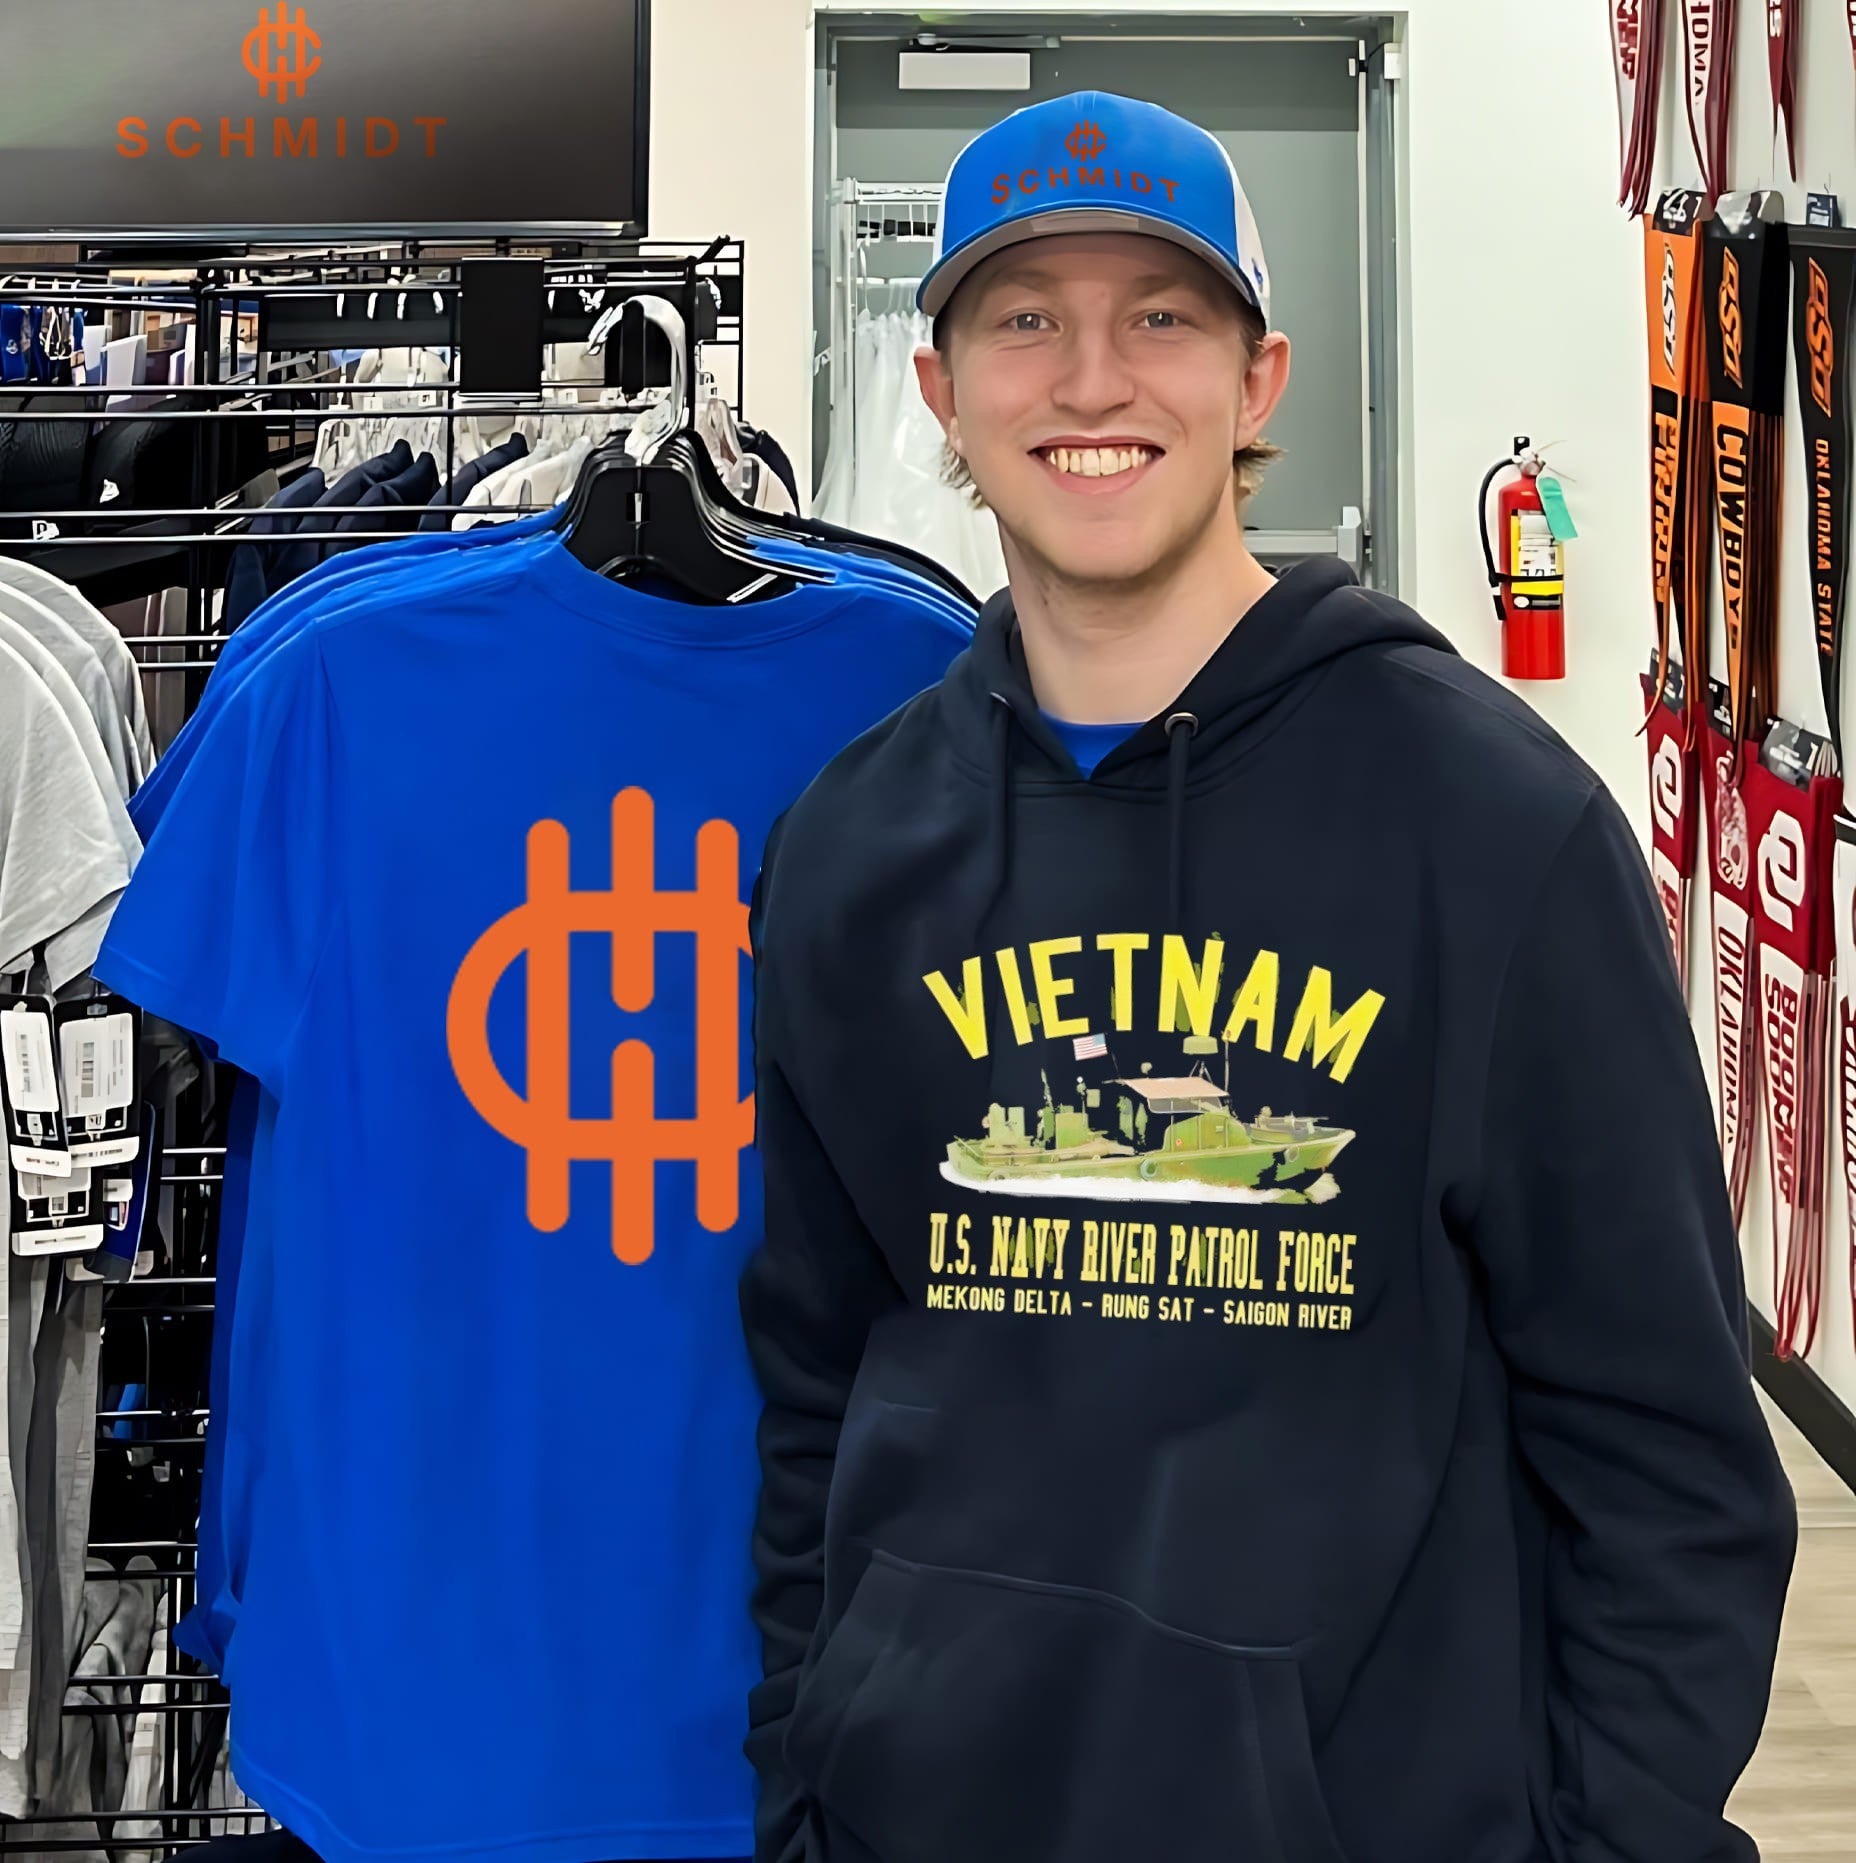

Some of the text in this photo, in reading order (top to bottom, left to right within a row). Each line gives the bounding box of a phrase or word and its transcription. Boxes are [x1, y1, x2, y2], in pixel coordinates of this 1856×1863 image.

[116, 116, 447, 158] SCHMIDT
[991, 166, 1180, 205] SCHMIDT
[1815, 438, 1832, 570] OKLAHOMA
[922, 933, 1386, 1085] VIETNAM
[930, 1212, 1357, 1295] U.S. NAVY RIVER PATROL FORCE
[926, 1283, 1006, 1313] MEKONG
[1013, 1288, 1072, 1316] DELTA
[1101, 1293, 1150, 1320] RUNG
[1158, 1296, 1195, 1322] SAT
[1223, 1299, 1290, 1327] SAIGON
[1298, 1303, 1352, 1330] RIVER
